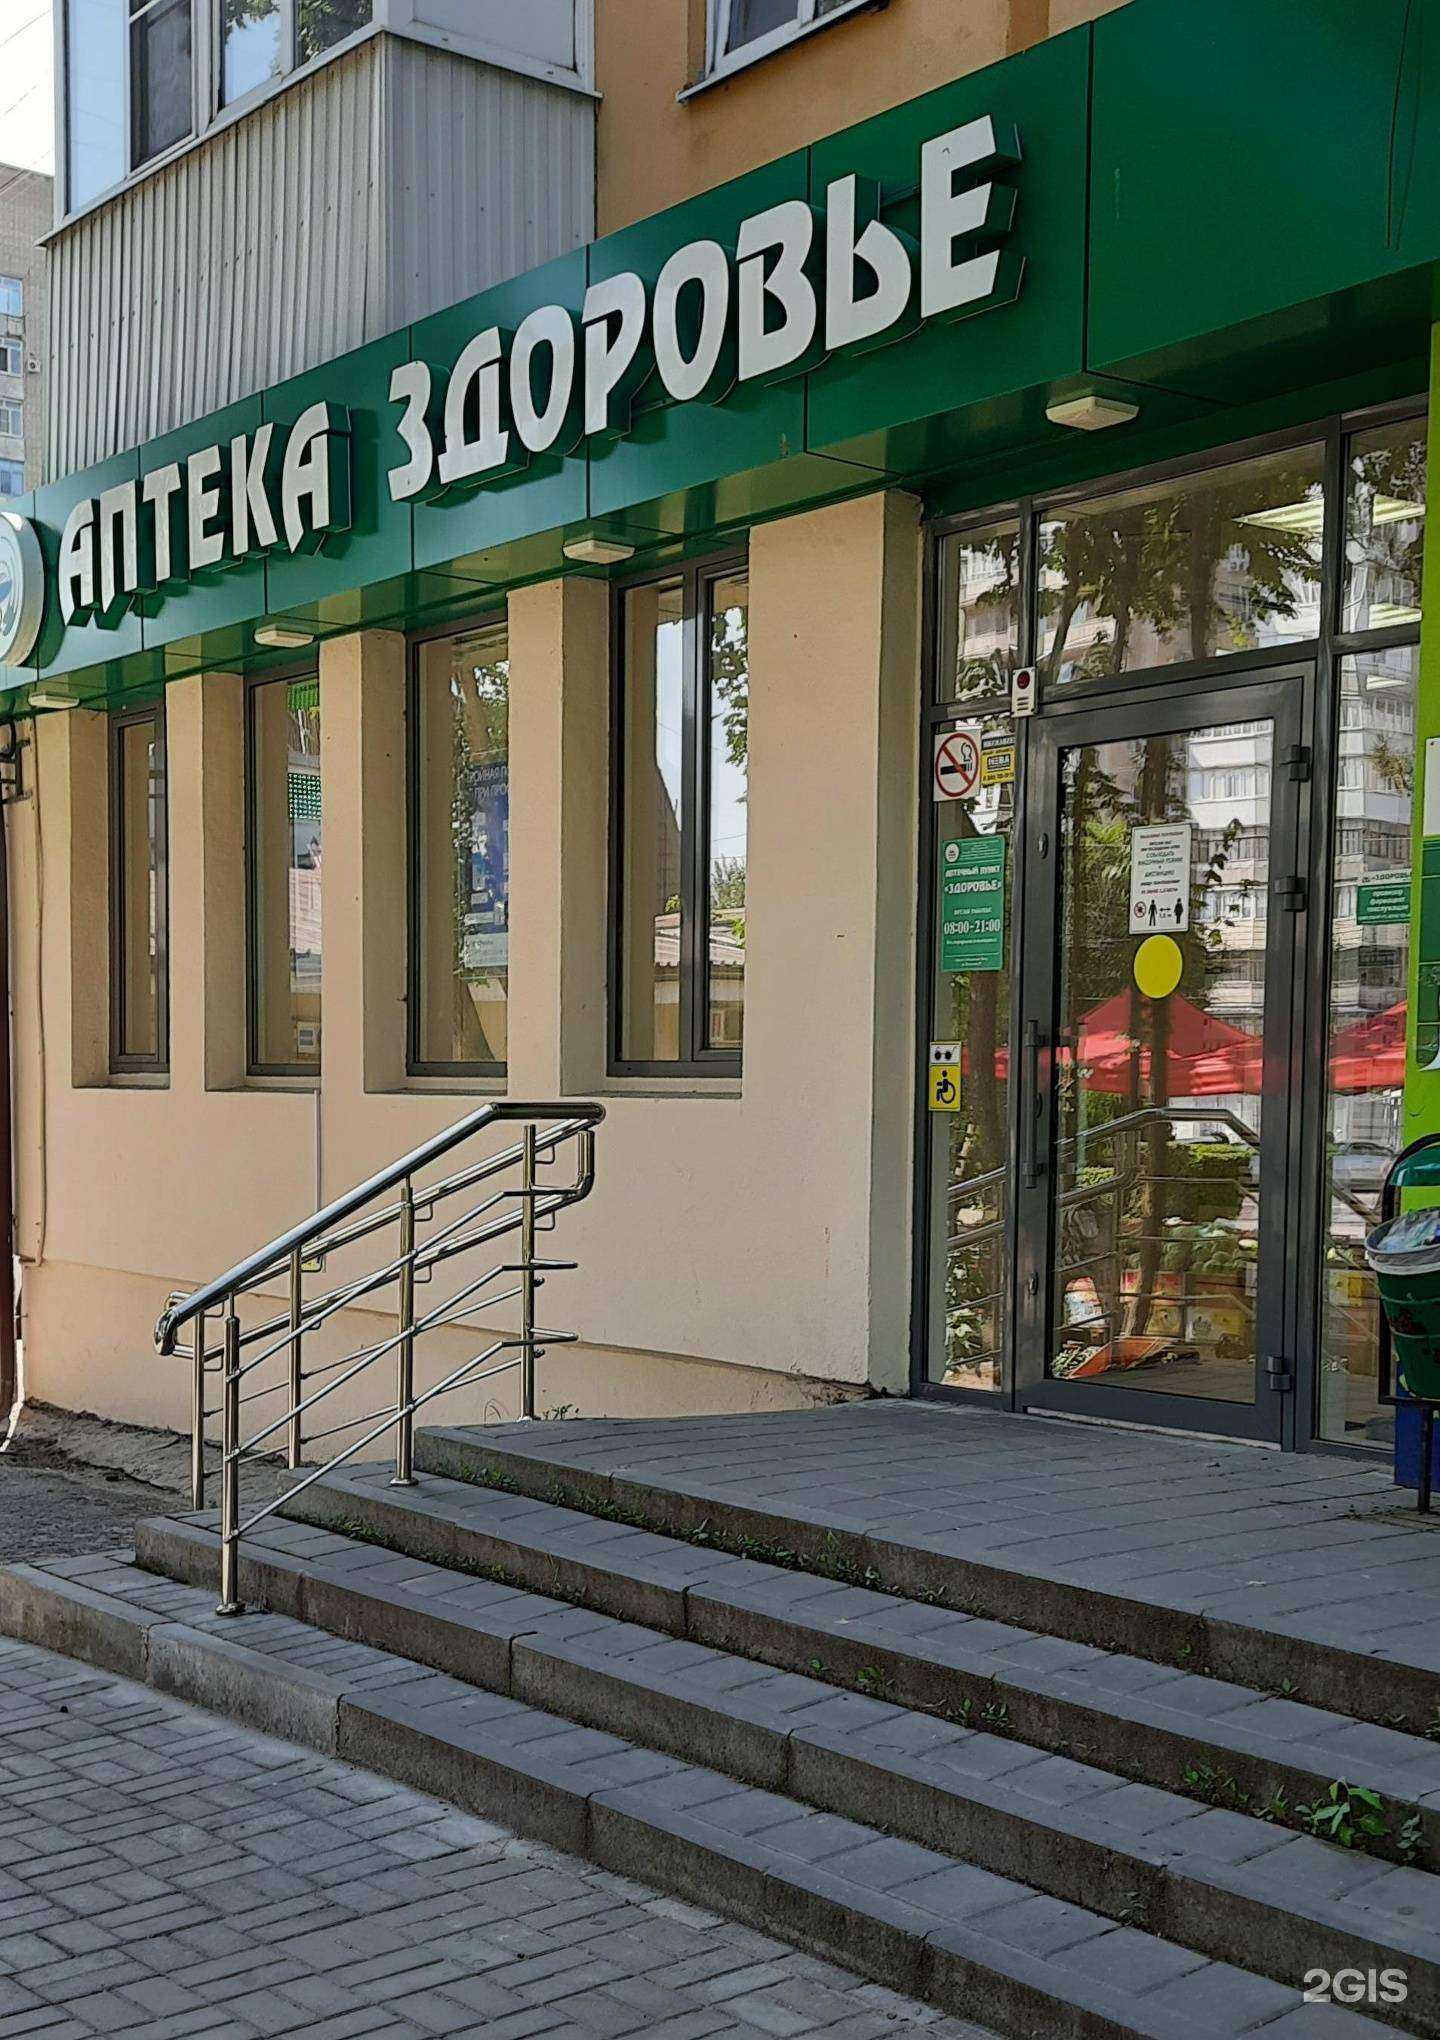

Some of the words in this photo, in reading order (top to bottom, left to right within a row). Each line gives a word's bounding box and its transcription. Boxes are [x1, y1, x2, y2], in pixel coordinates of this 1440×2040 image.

[58, 400, 331, 627] АПТЕКА
[387, 113, 1003, 503] ЗДОРОВЬЕ
[943, 918, 1001, 935] 08:00-21:00
